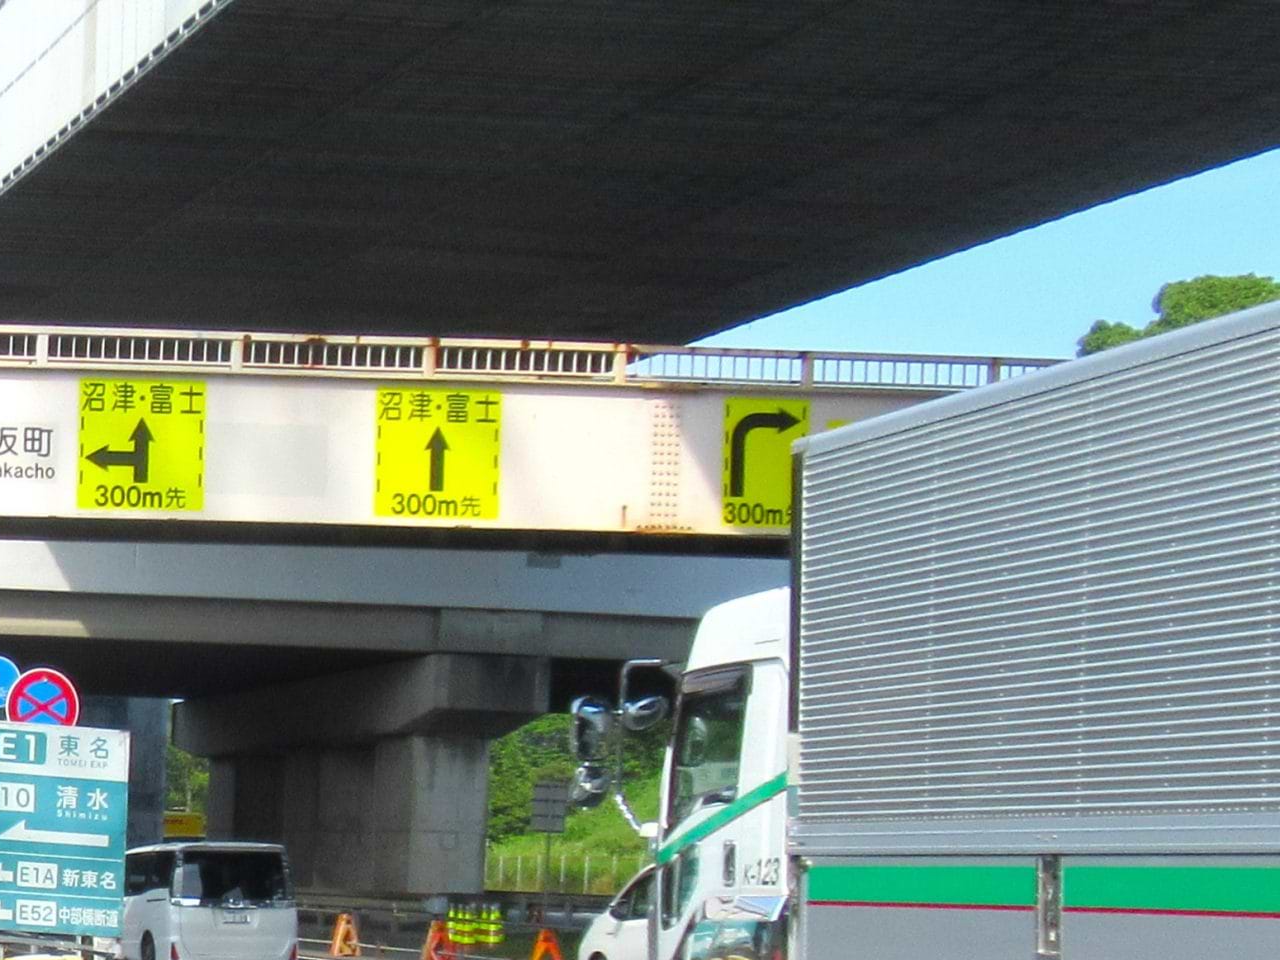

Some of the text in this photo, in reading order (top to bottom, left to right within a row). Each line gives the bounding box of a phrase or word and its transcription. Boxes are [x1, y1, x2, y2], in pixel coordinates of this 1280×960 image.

[82, 382, 204, 415] 沼津・富士
[378, 391, 500, 423] 沼津・富士
[94, 484, 187, 509] 300m先
[391, 493, 481, 517] 300m先
[58, 735, 110, 760] 東名
[57, 758, 87, 769] TOMEI
[0, 784, 109, 811] 10 清水
[56, 809, 109, 821] Shimizu
[20, 866, 117, 890] E1A 新東名
[743, 857, 781, 886] K-123
[20, 904, 54, 923] E52
